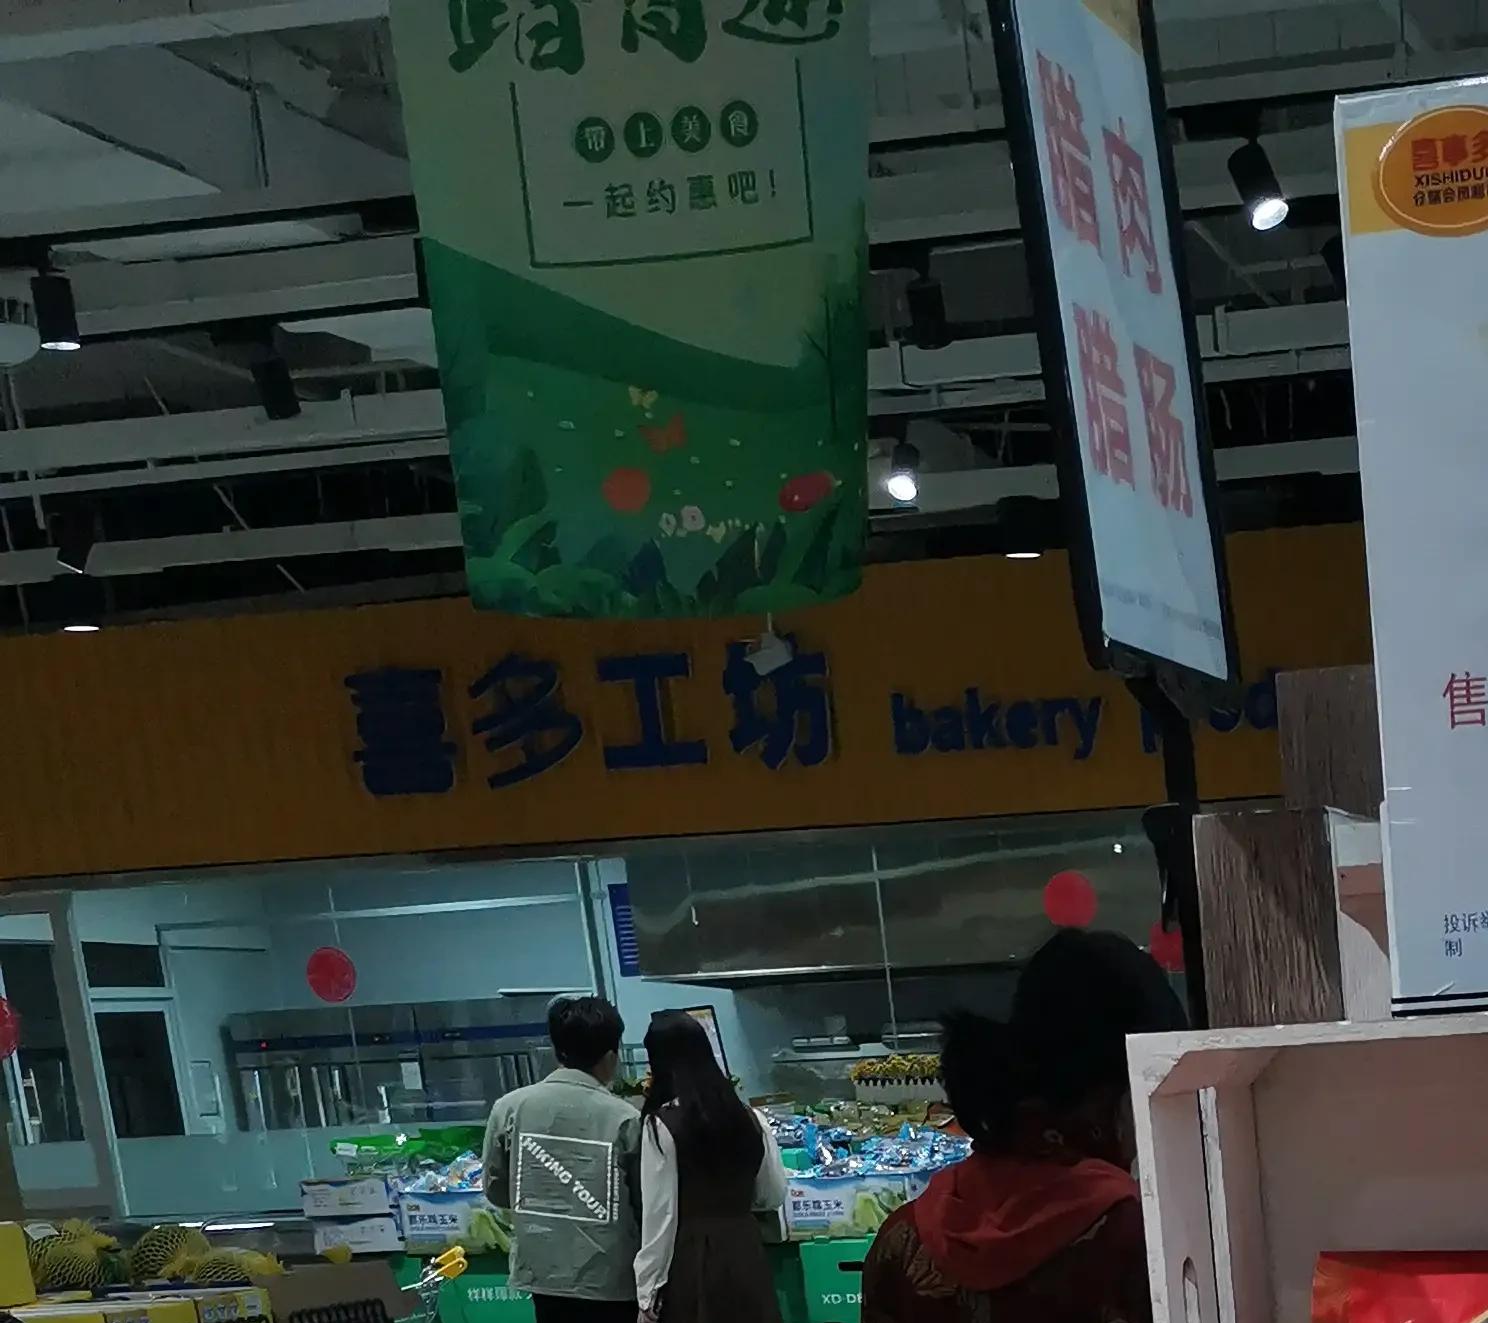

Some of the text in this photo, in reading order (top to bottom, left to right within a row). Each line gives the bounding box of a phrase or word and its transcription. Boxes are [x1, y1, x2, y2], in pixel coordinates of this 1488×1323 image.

[343, 630, 833, 796] 喜多工坊
[890, 687, 1104, 761] bakery
